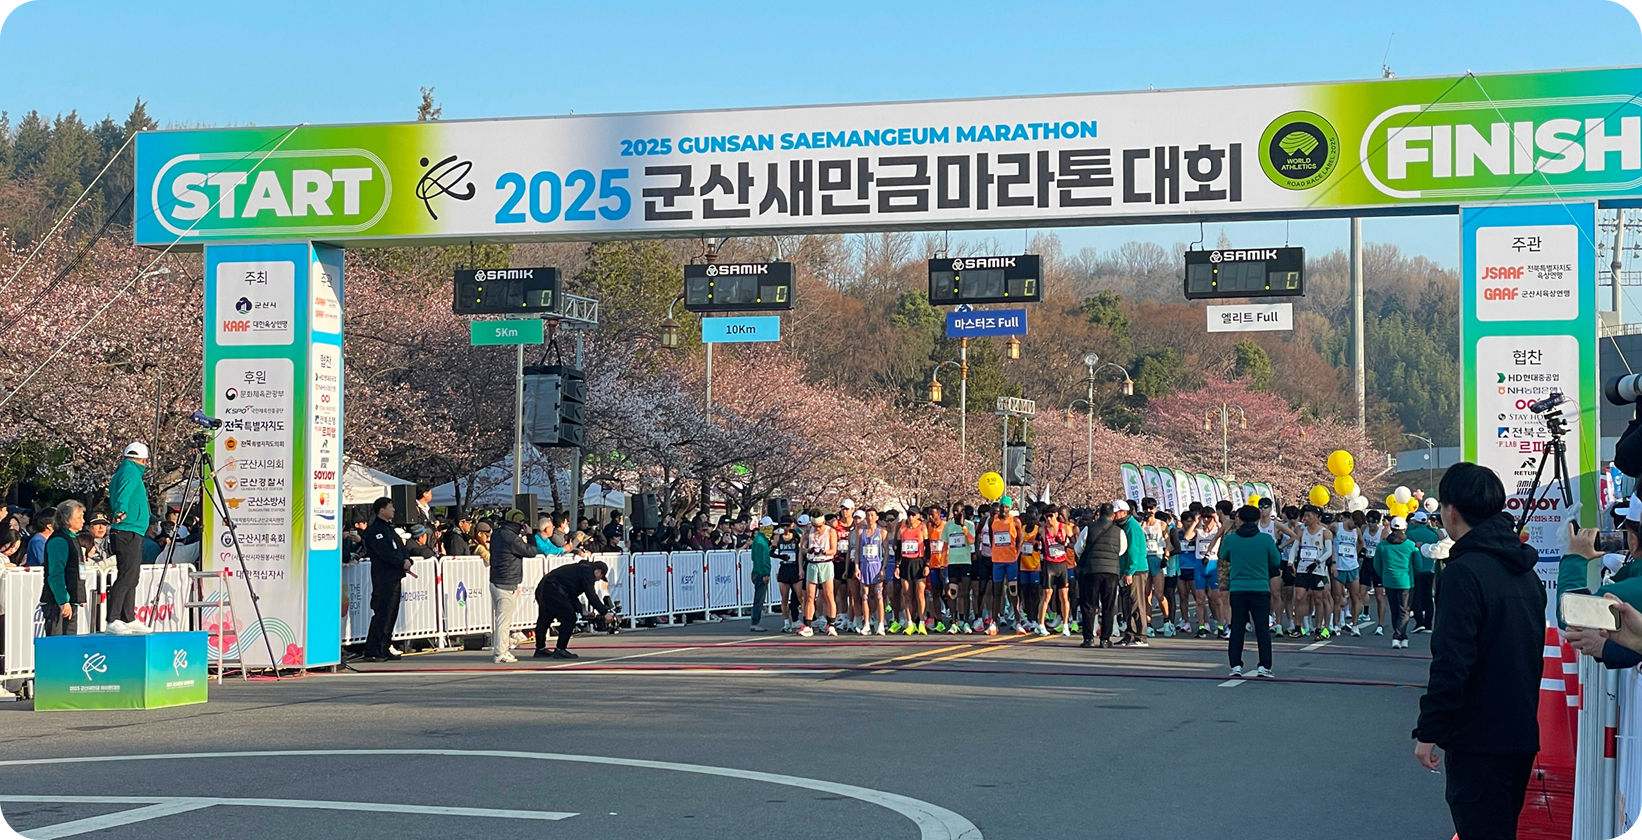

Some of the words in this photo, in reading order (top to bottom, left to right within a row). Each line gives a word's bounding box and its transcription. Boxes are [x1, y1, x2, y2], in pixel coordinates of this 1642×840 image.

[620, 137, 672, 157] 2025
[677, 132, 774, 154] GUNSAN
[779, 125, 951, 150] SAEMANGEUM
[956, 120, 1098, 144] MARATHON
[1386, 115, 1641, 180] FINISH
[1306, 174, 1324, 185] RACE
[1322, 156, 1336, 175] LABEL
[170, 166, 374, 221] START
[494, 168, 632, 225] 2025
[1512, 236, 1542, 252] 주관
[1223, 249, 1277, 261] SAMIK
[719, 264, 768, 275] SAMIK
[965, 257, 1016, 268] SAMIK
[1527, 264, 1572, 272] 전북특별자치도
[244, 271, 268, 285] 주최
[486, 270, 534, 280] SAMIK
[1286, 271, 1298, 289] 0
[1482, 266, 1524, 280] JSAAF
[776, 286, 788, 302] 0
[1024, 279, 1036, 296] 0
[1484, 288, 1519, 300] GAAF
[540, 290, 552, 307] 0
[954, 318, 996, 330] 마스터즈
[998, 316, 1019, 329] Full
[1221, 312, 1254, 324] 엘리트
[1256, 310, 1278, 323] Full
[223, 320, 250, 332] KAAF
[253, 320, 288, 329] 대한육상연맹
[495, 326, 518, 337] 5Km
[726, 324, 756, 335] 10Km
[1512, 350, 1543, 365] 협찬
[244, 370, 266, 384] 후원
[240, 390, 284, 398] 문화체육관광부
[224, 418, 285, 432] 전북특별자치도
[240, 460, 284, 470] 군산시의회
[314, 470, 335, 480] SOYJOY
[240, 478, 284, 487] 군산경찰서
[248, 497, 286, 506] 군산소방서
[238, 534, 285, 544] 군산시체육회
